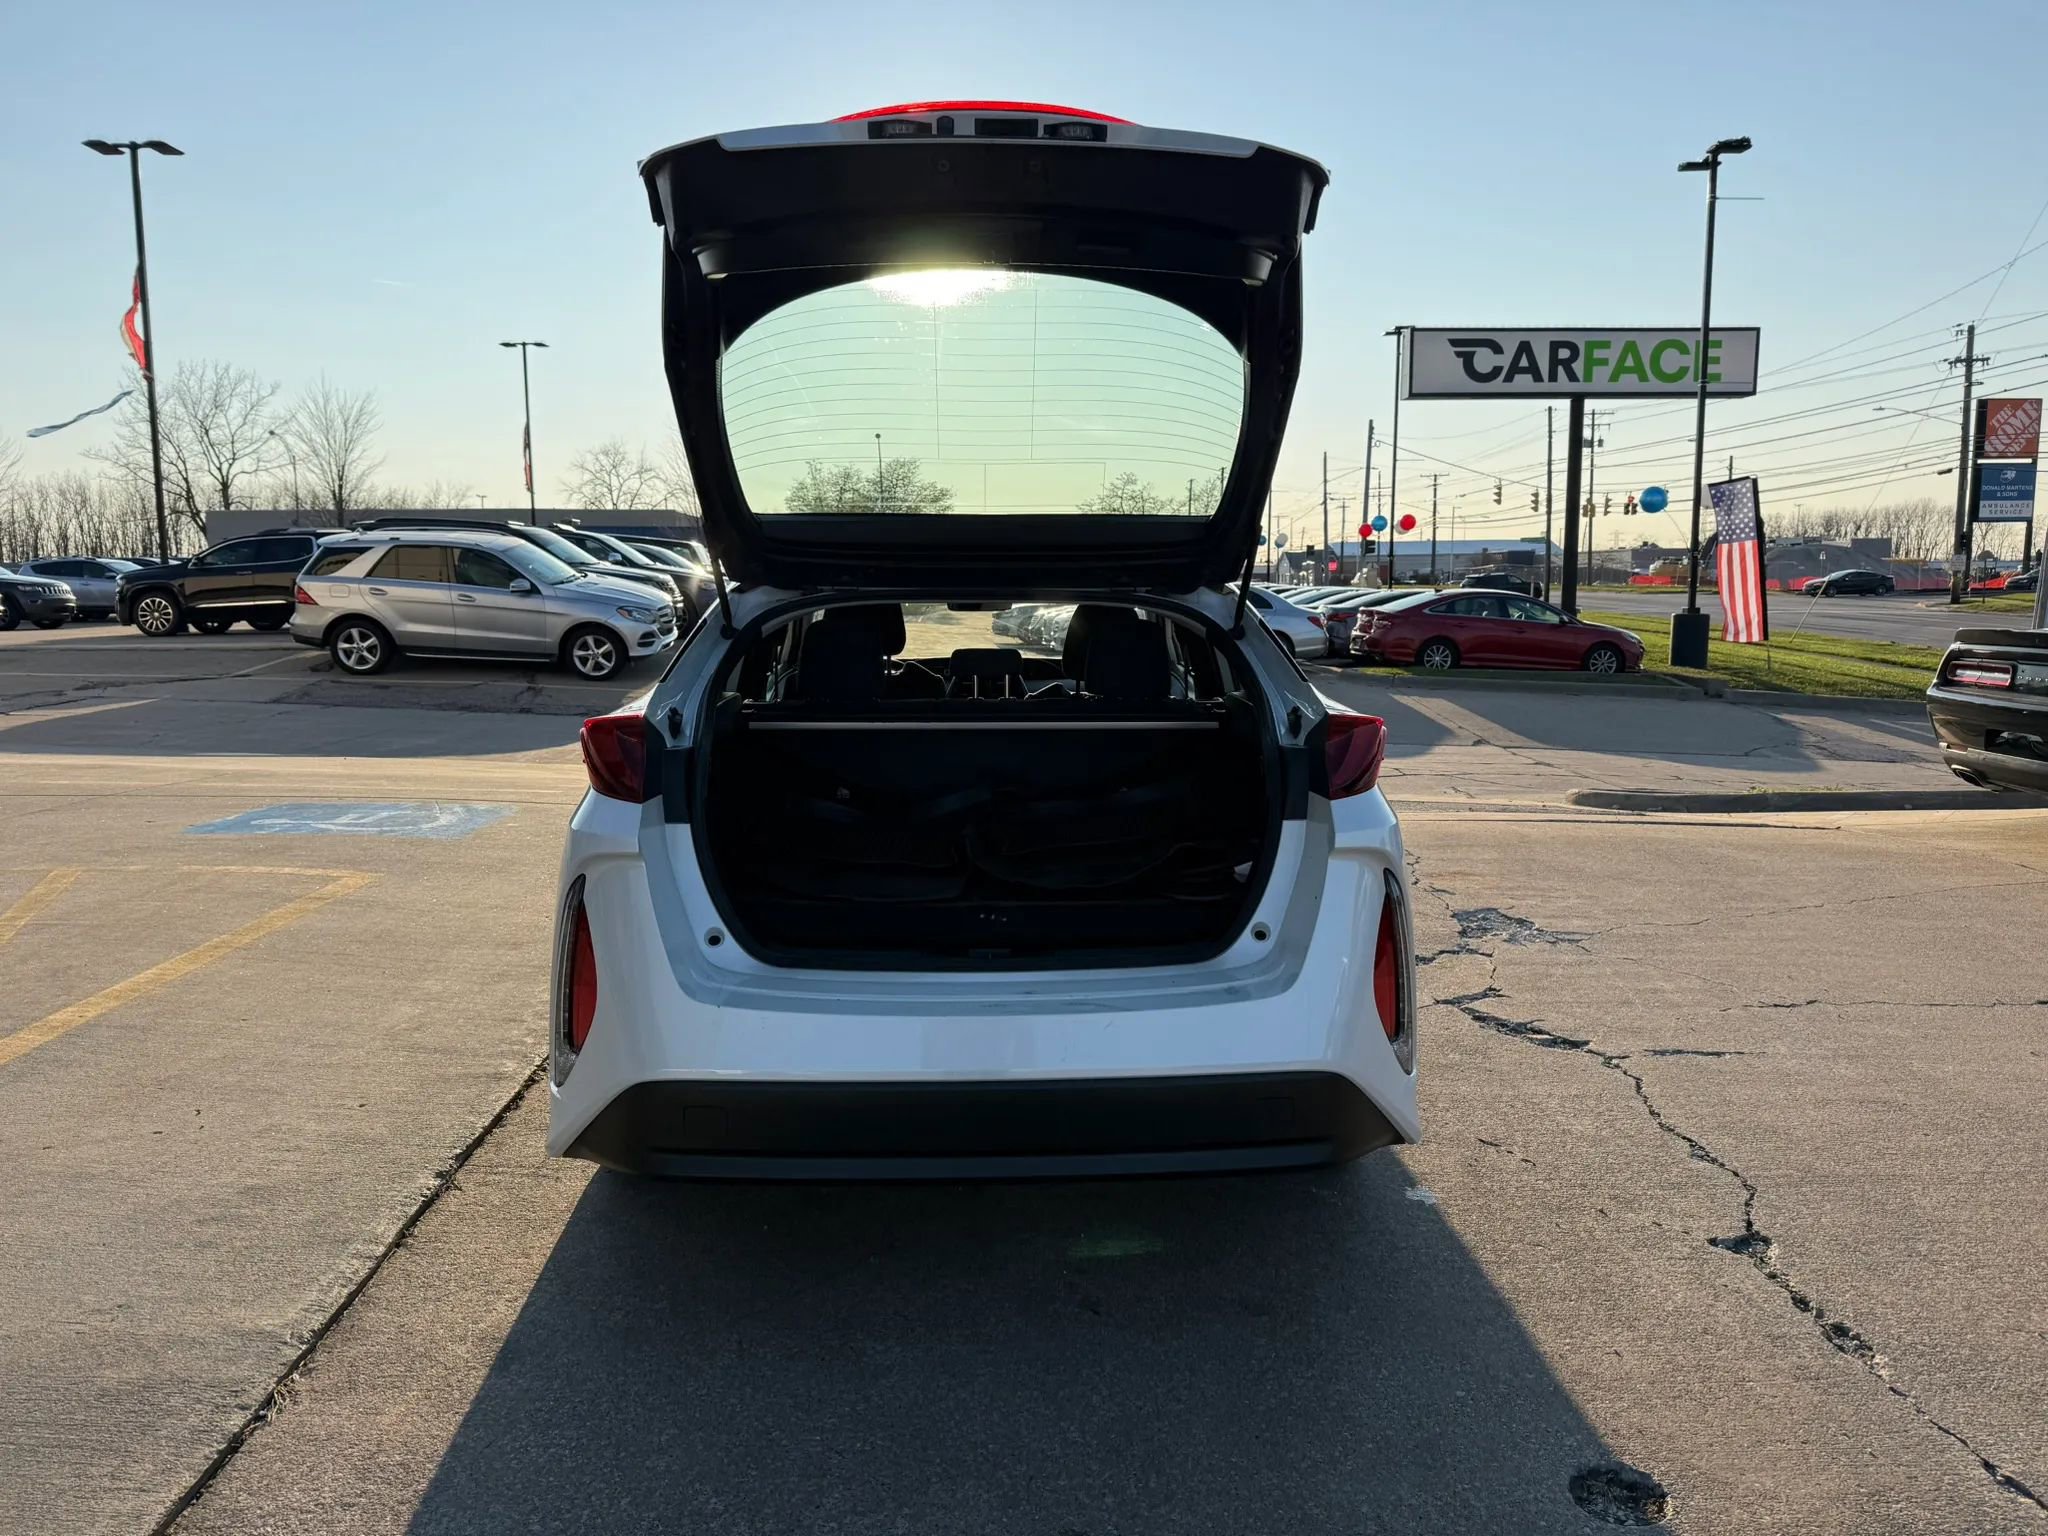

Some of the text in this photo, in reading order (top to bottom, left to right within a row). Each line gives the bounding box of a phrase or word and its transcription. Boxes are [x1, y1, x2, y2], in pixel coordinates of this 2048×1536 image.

[1447, 338, 1723, 384] CARFACE
[1984, 400, 2040, 457] HOME
[1990, 403, 2015, 429] THE
